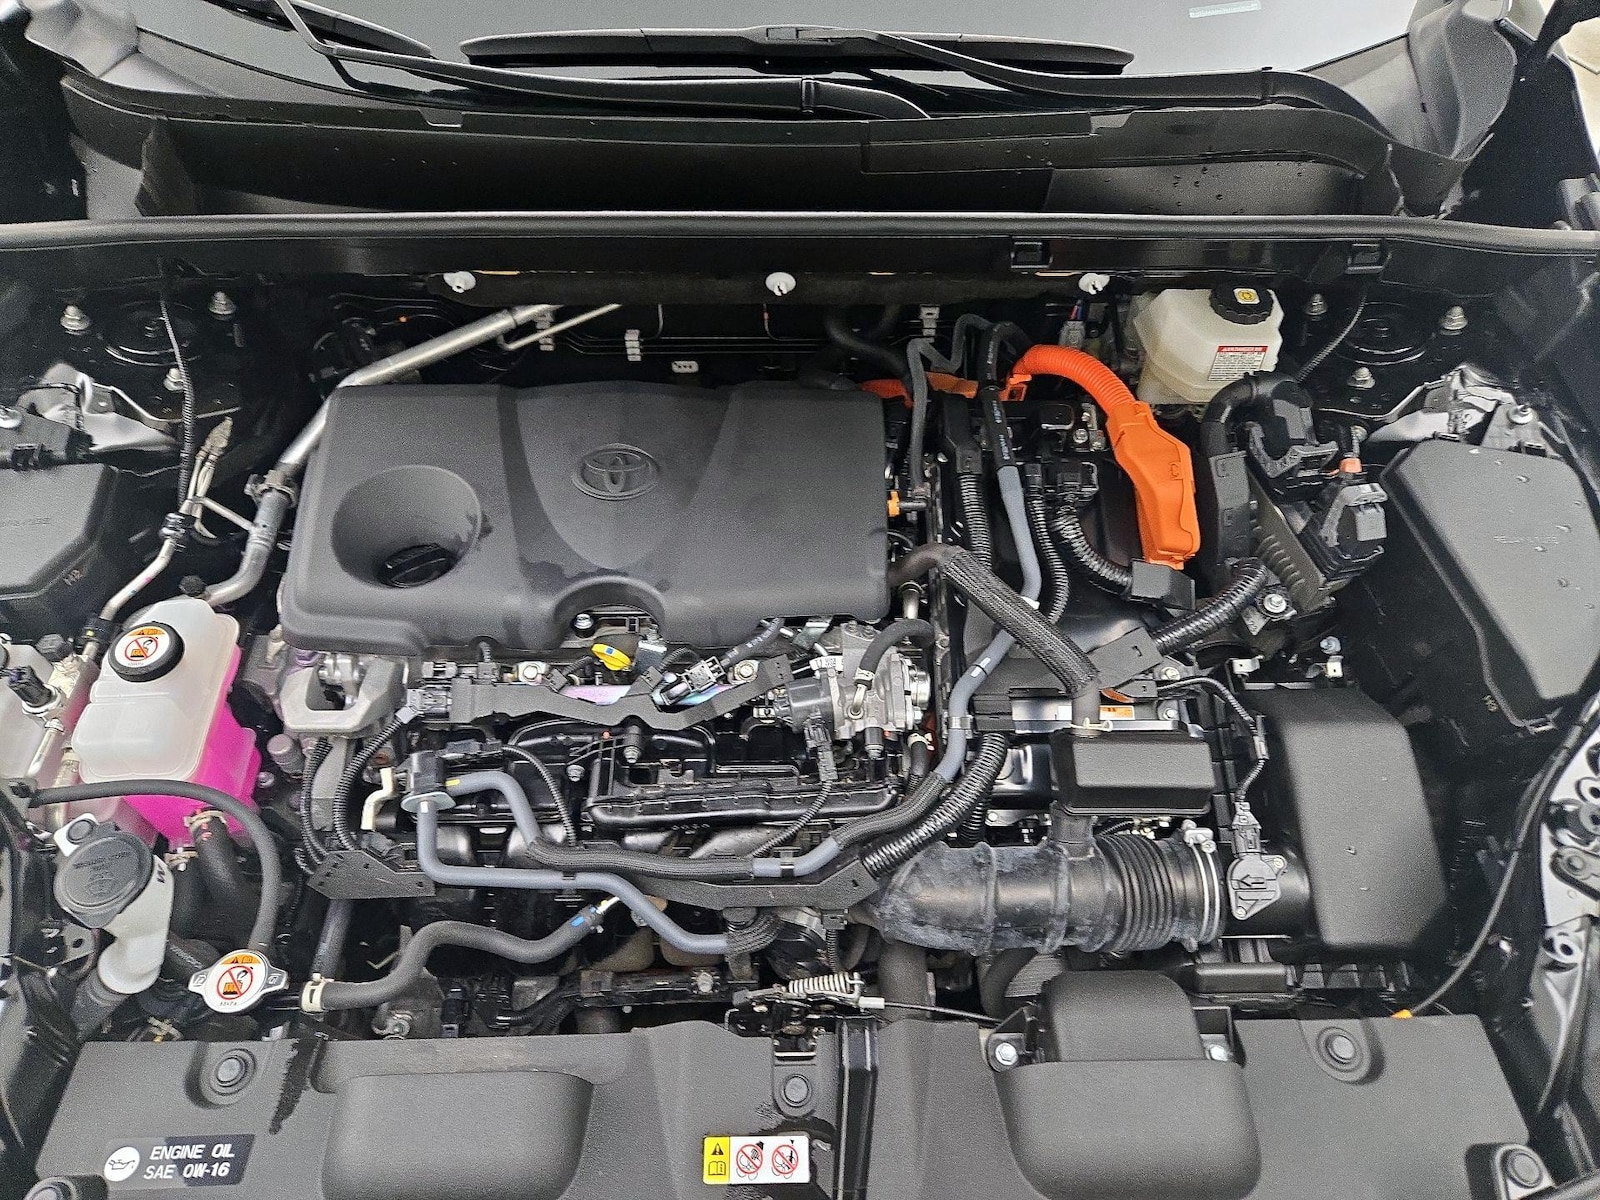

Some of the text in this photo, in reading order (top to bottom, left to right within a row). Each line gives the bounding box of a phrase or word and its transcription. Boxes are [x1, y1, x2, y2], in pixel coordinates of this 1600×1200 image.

[149, 1143, 236, 1161] ENGINE OIL
[143, 1161, 231, 1180] SAE 0W-16
